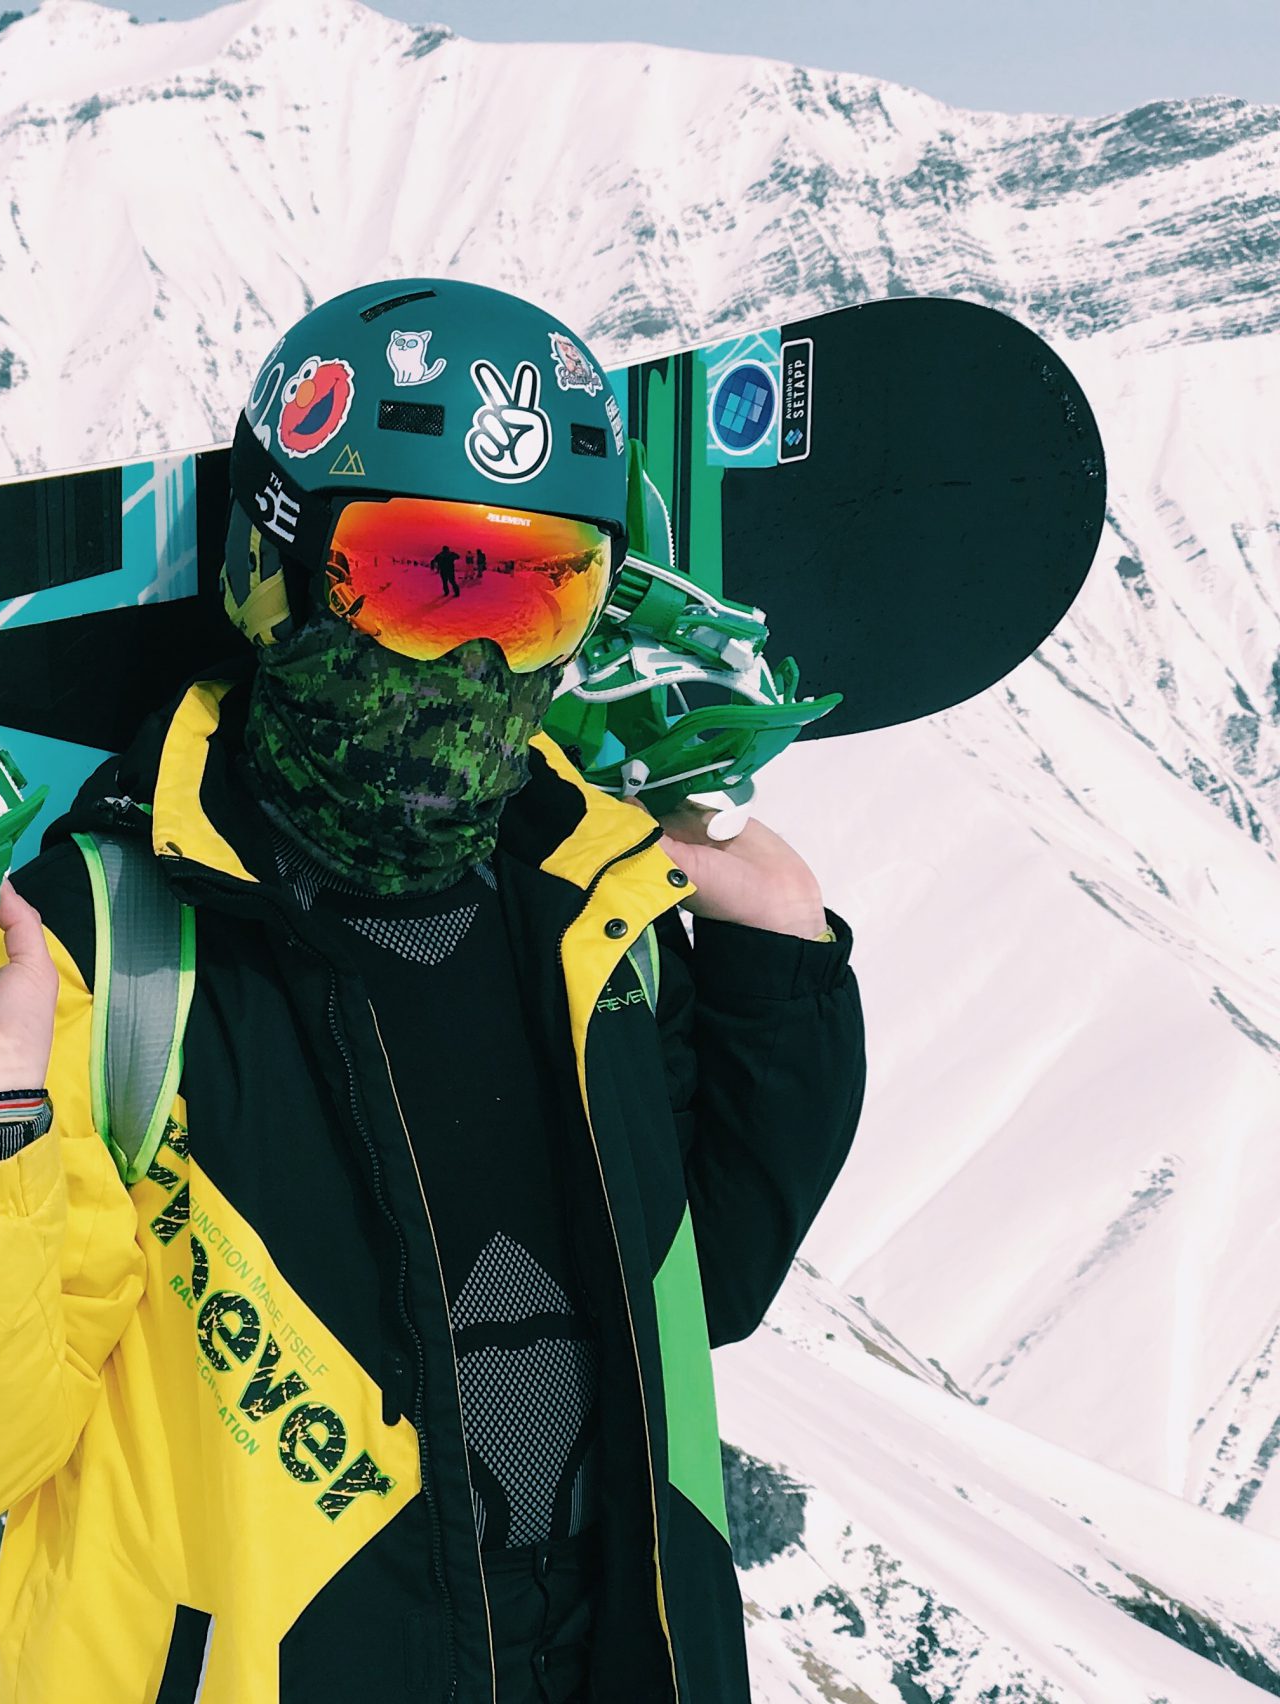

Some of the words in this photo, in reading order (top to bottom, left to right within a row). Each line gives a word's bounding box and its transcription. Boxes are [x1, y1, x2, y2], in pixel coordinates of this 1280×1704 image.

[793, 360, 805, 418] SETAPP
[189, 1197, 250, 1280] FUNCTION
[249, 1275, 282, 1322] MADE
[280, 1323, 328, 1378] ITSELF
